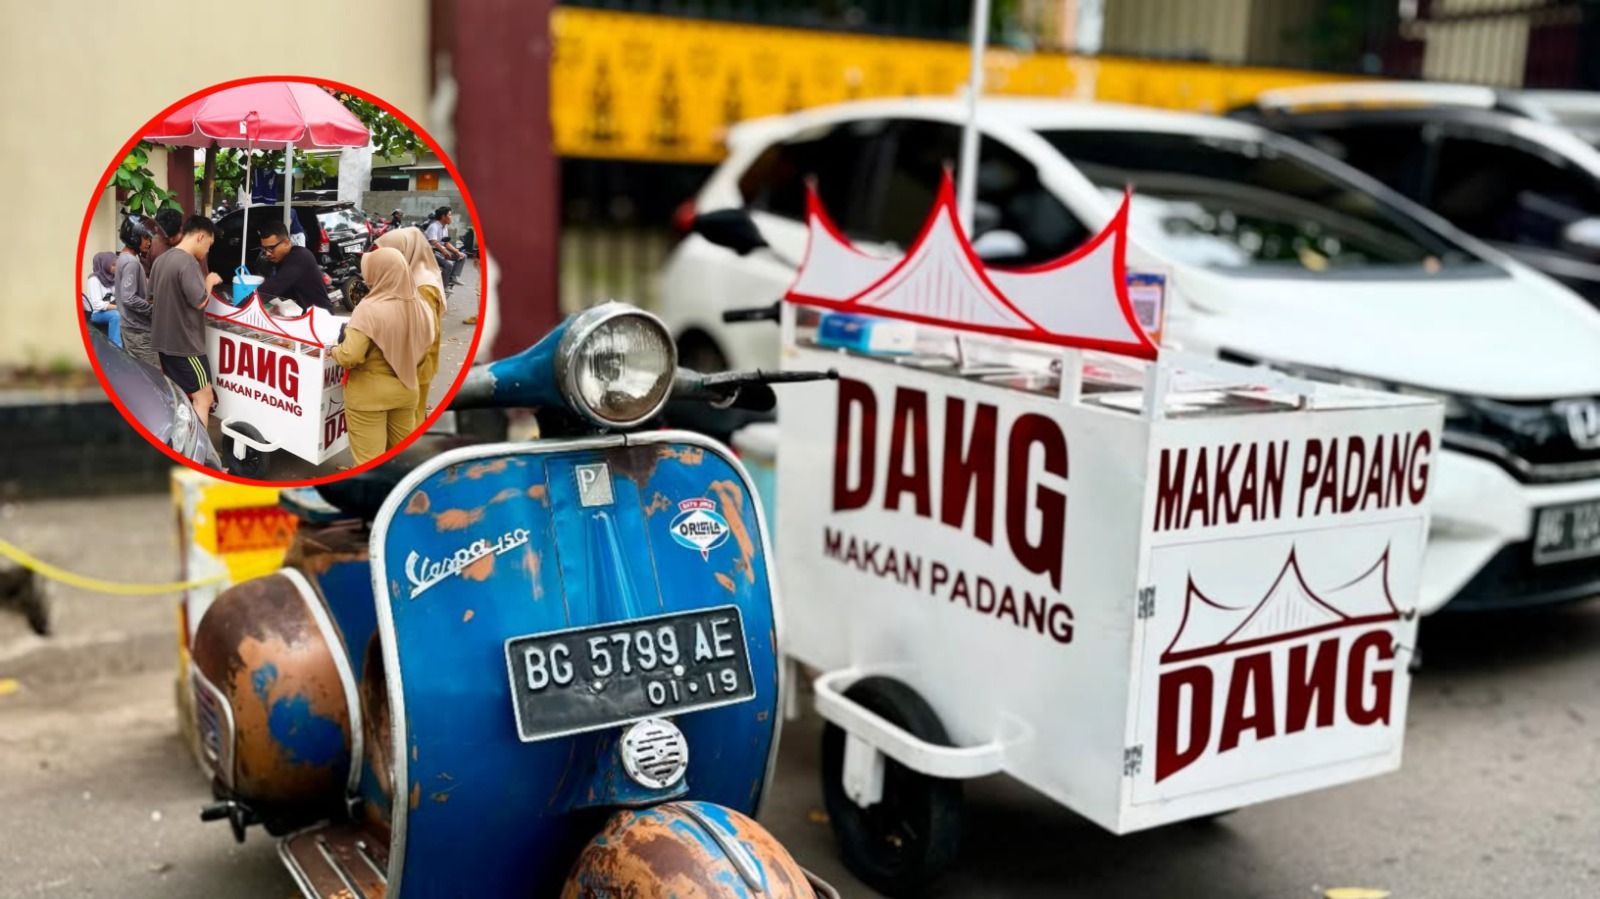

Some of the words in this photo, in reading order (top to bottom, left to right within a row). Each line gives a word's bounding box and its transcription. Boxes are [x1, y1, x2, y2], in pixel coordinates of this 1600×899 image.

[216, 376, 252, 398] MAKAN
[254, 390, 303, 417] PADANG
[580, 469, 595, 493] P
[1153, 440, 1289, 532] MAKAN
[1297, 430, 1431, 518] PADANG
[405, 539, 486, 600] Vespa
[824, 527, 922, 589] MAKAN
[930, 562, 1075, 644] PADANG
[524, 643, 573, 690] BG
[588, 626, 680, 676] 5799
[695, 618, 735, 662] AE
